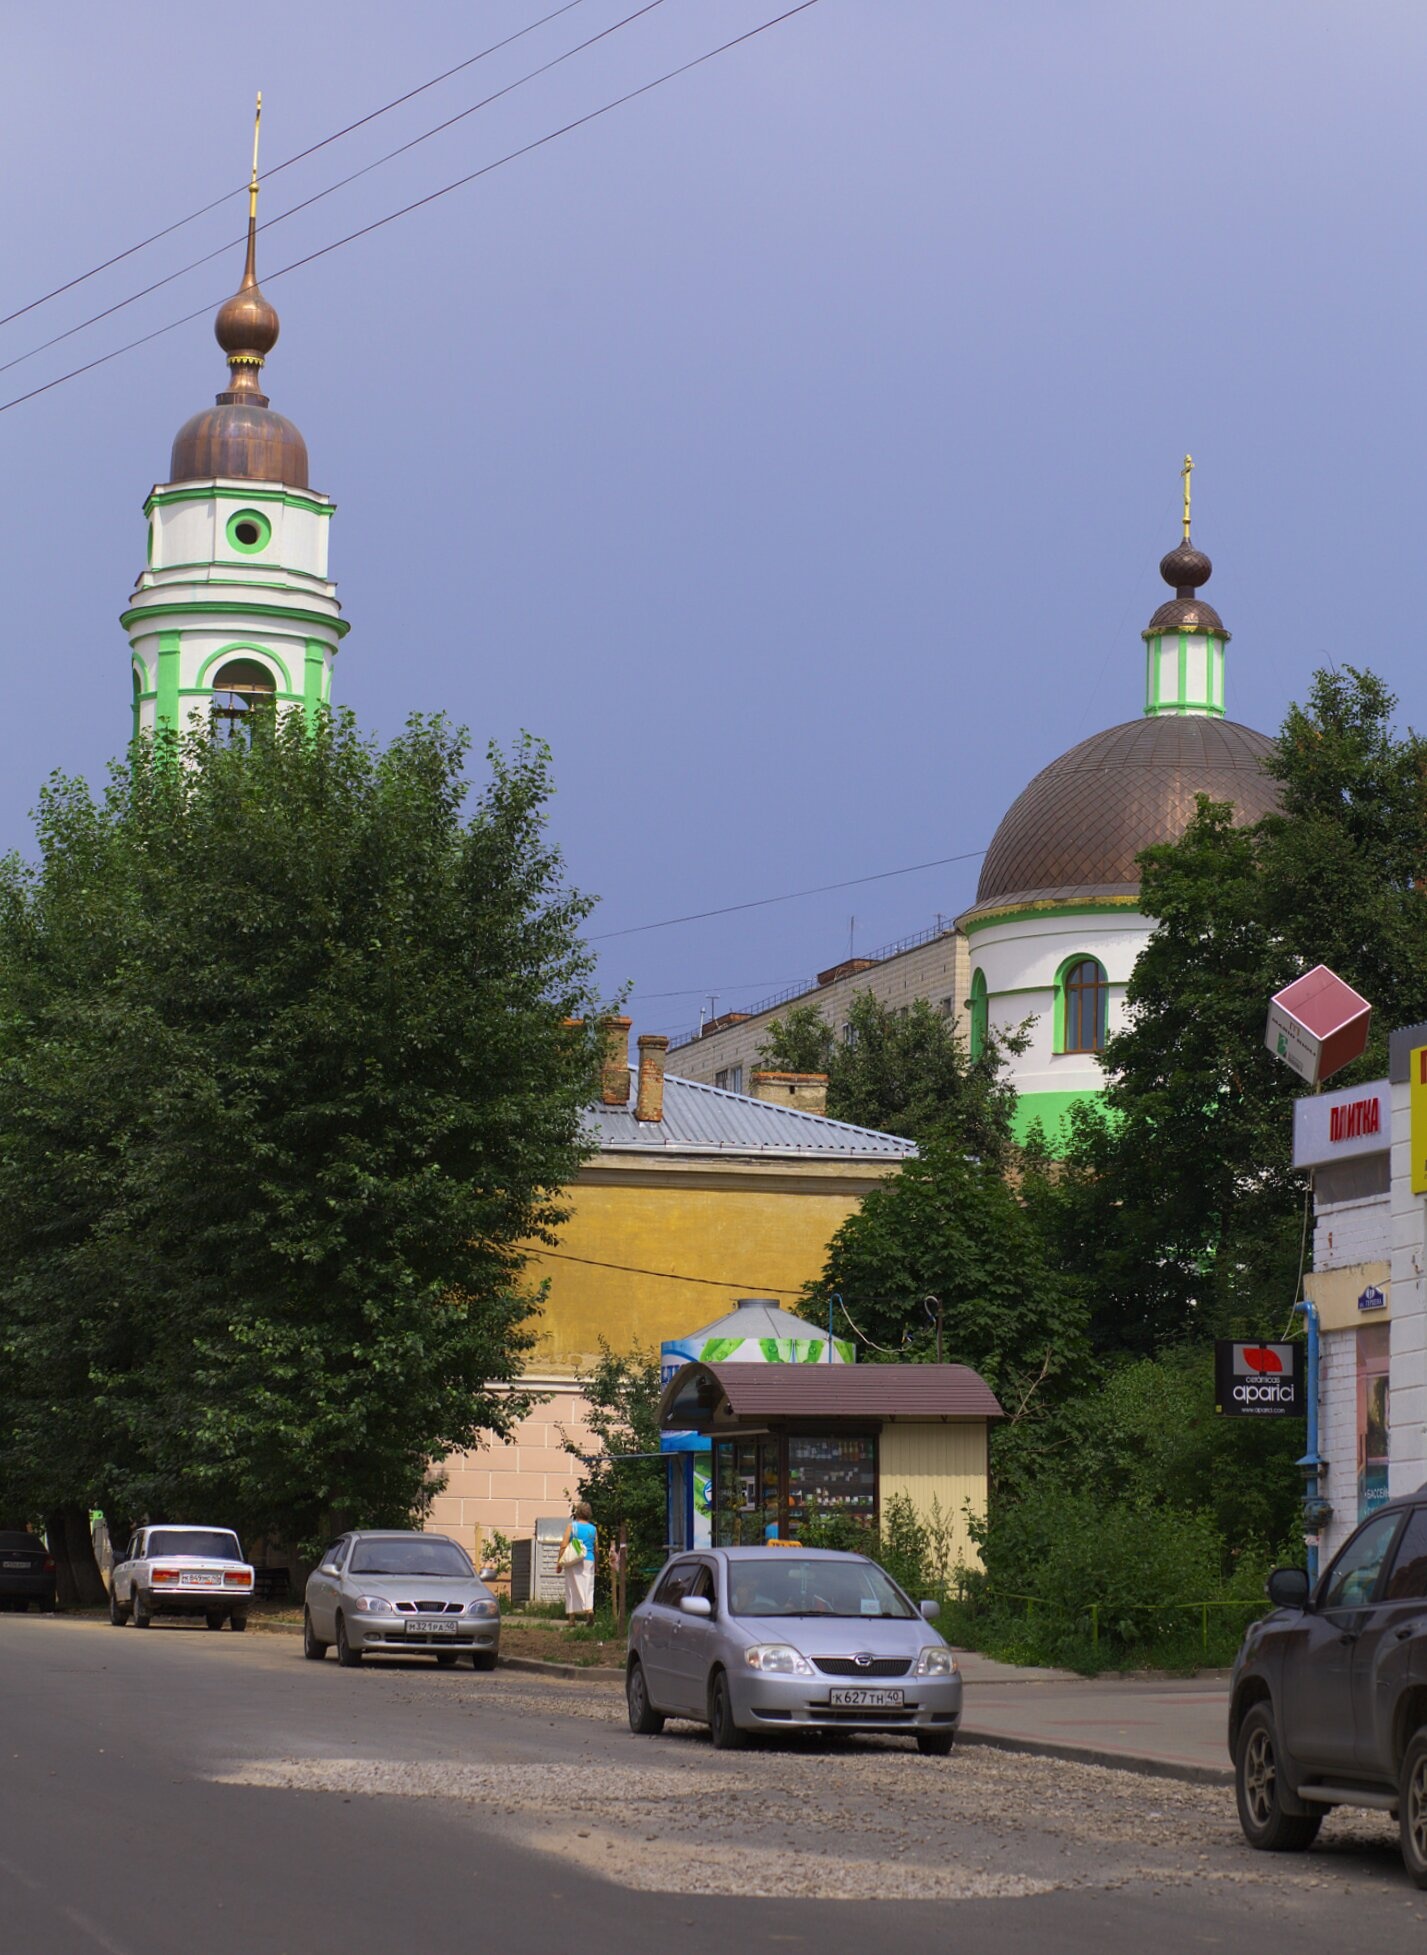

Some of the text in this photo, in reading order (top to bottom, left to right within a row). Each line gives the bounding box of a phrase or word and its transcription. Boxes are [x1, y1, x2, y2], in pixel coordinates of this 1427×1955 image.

[1330, 1097, 1379, 1142] ПЛИТКА
[1233, 1384, 1295, 1404] aparici
[887, 1691, 899, 1701] 40
